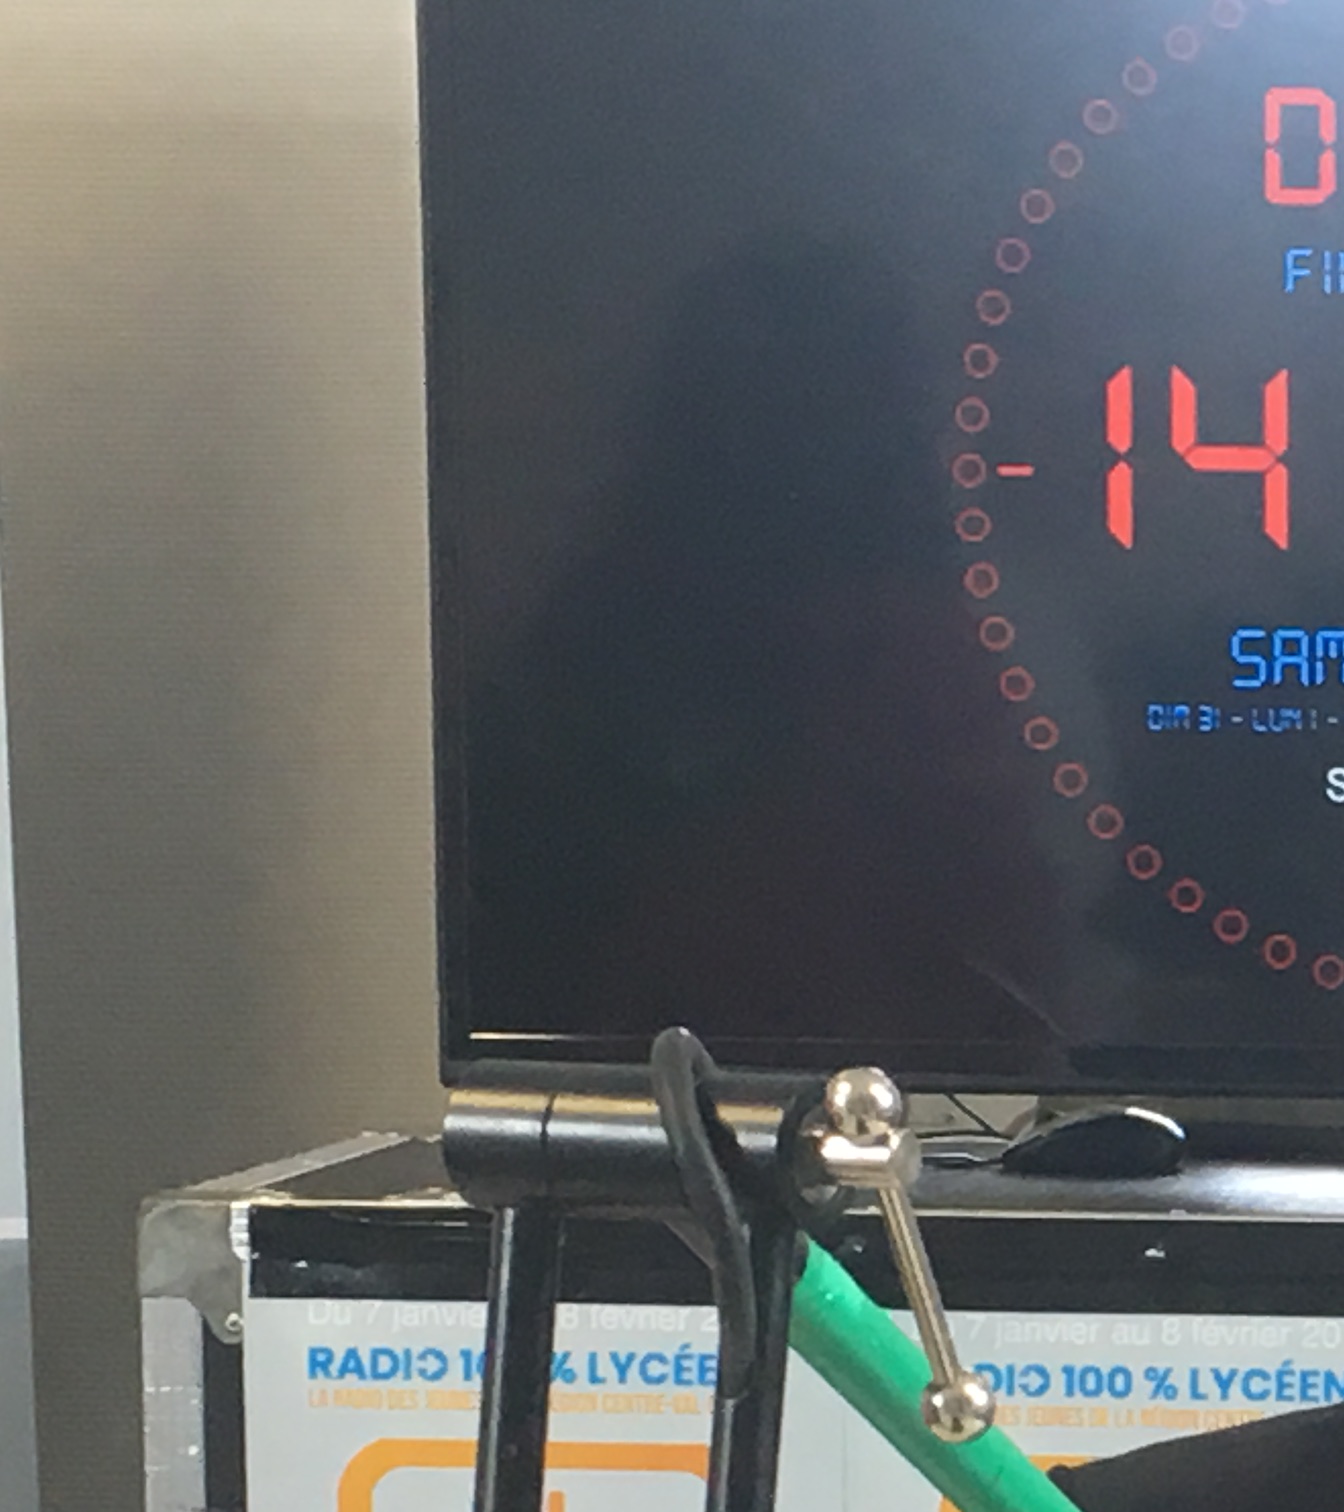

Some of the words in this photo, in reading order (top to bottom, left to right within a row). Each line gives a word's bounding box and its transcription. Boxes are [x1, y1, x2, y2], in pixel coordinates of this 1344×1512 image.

[391, 1303, 487, 1332] janvie
[1111, 1324, 1150, 1346] au
[1161, 1317, 1181, 1346] 8
[587, 1342, 718, 1387] LYCÉE
[1061, 1363, 1134, 1399] 100
[1143, 1365, 1179, 1400] %
